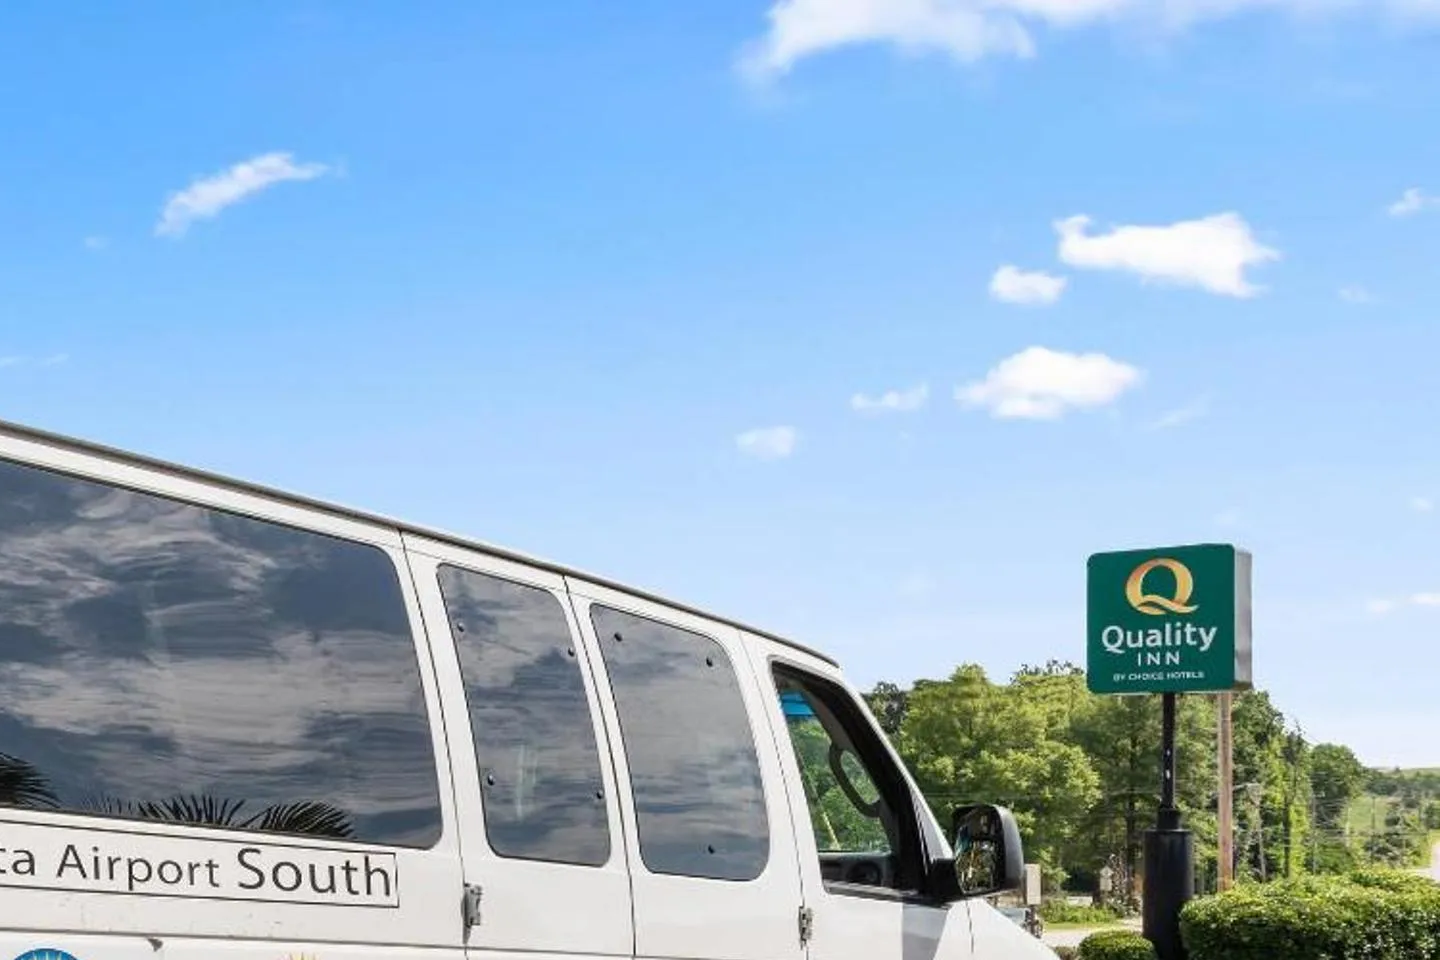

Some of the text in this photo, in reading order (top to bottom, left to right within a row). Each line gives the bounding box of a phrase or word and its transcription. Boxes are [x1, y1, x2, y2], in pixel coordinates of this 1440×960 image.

[1101, 621, 1218, 654] Quality
[1137, 652, 1181, 667] INN
[56, 844, 220, 891] Airport
[237, 847, 391, 897] South
